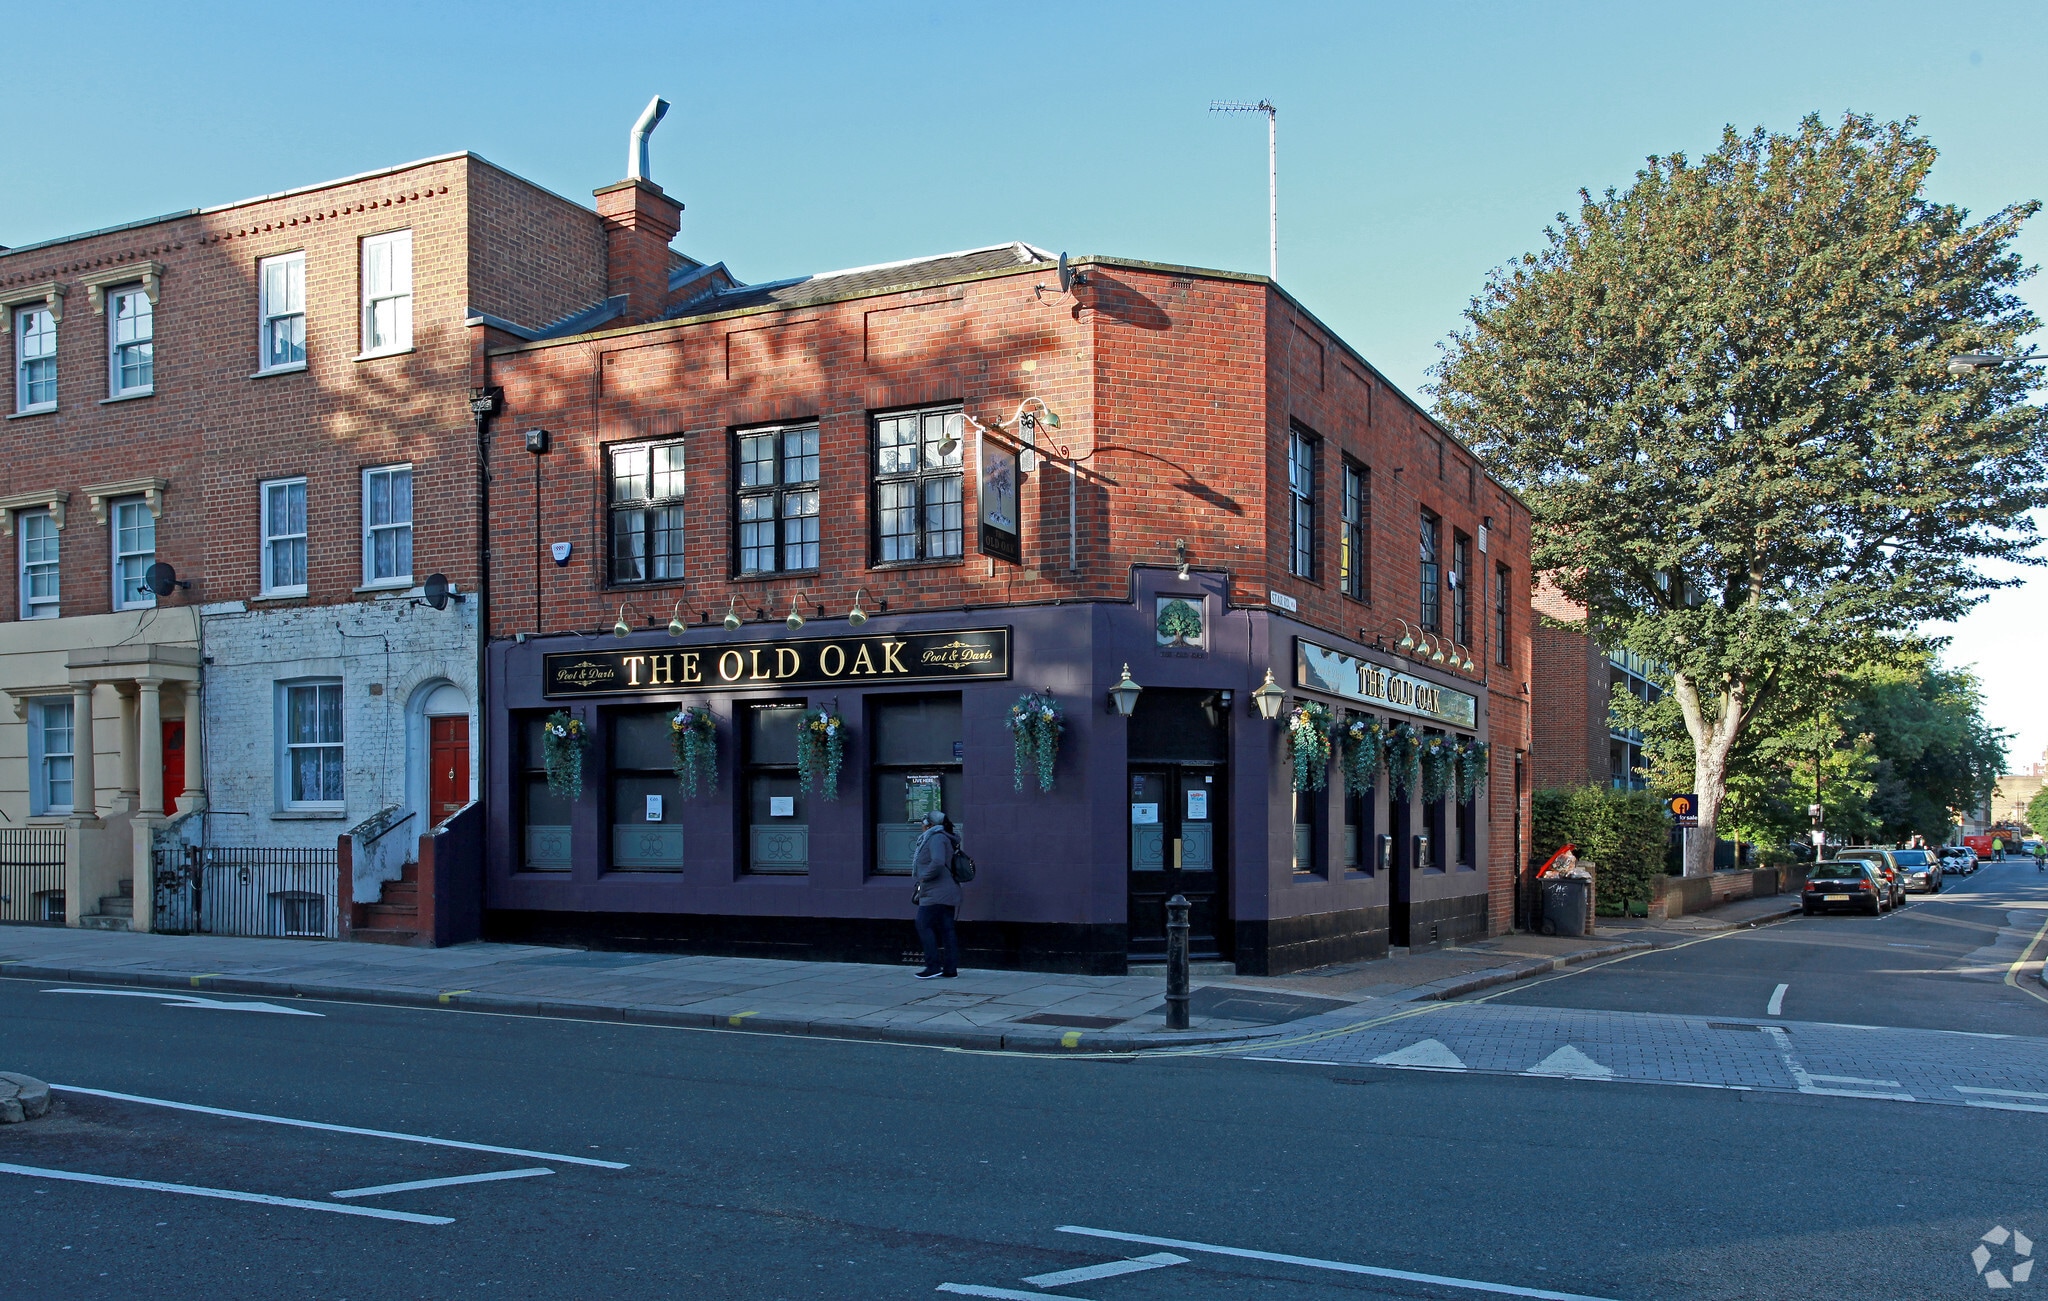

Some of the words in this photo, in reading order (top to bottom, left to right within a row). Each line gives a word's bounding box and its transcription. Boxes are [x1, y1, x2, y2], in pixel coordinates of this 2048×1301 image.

[985, 535, 999, 548] OLD
[920, 650, 948, 663] Pool
[949, 649, 958, 661] &
[960, 649, 993, 660] Darts
[623, 653, 702, 686] THE
[718, 647, 801, 681] OLD
[819, 642, 908, 677] OAK
[556, 669, 578, 681] Pool
[578, 669, 587, 679] &
[588, 668, 615, 679] Darts
[1359, 667, 1386, 699] THE
[1390, 676, 1414, 706] OLD
[1418, 685, 1440, 714] OAK
